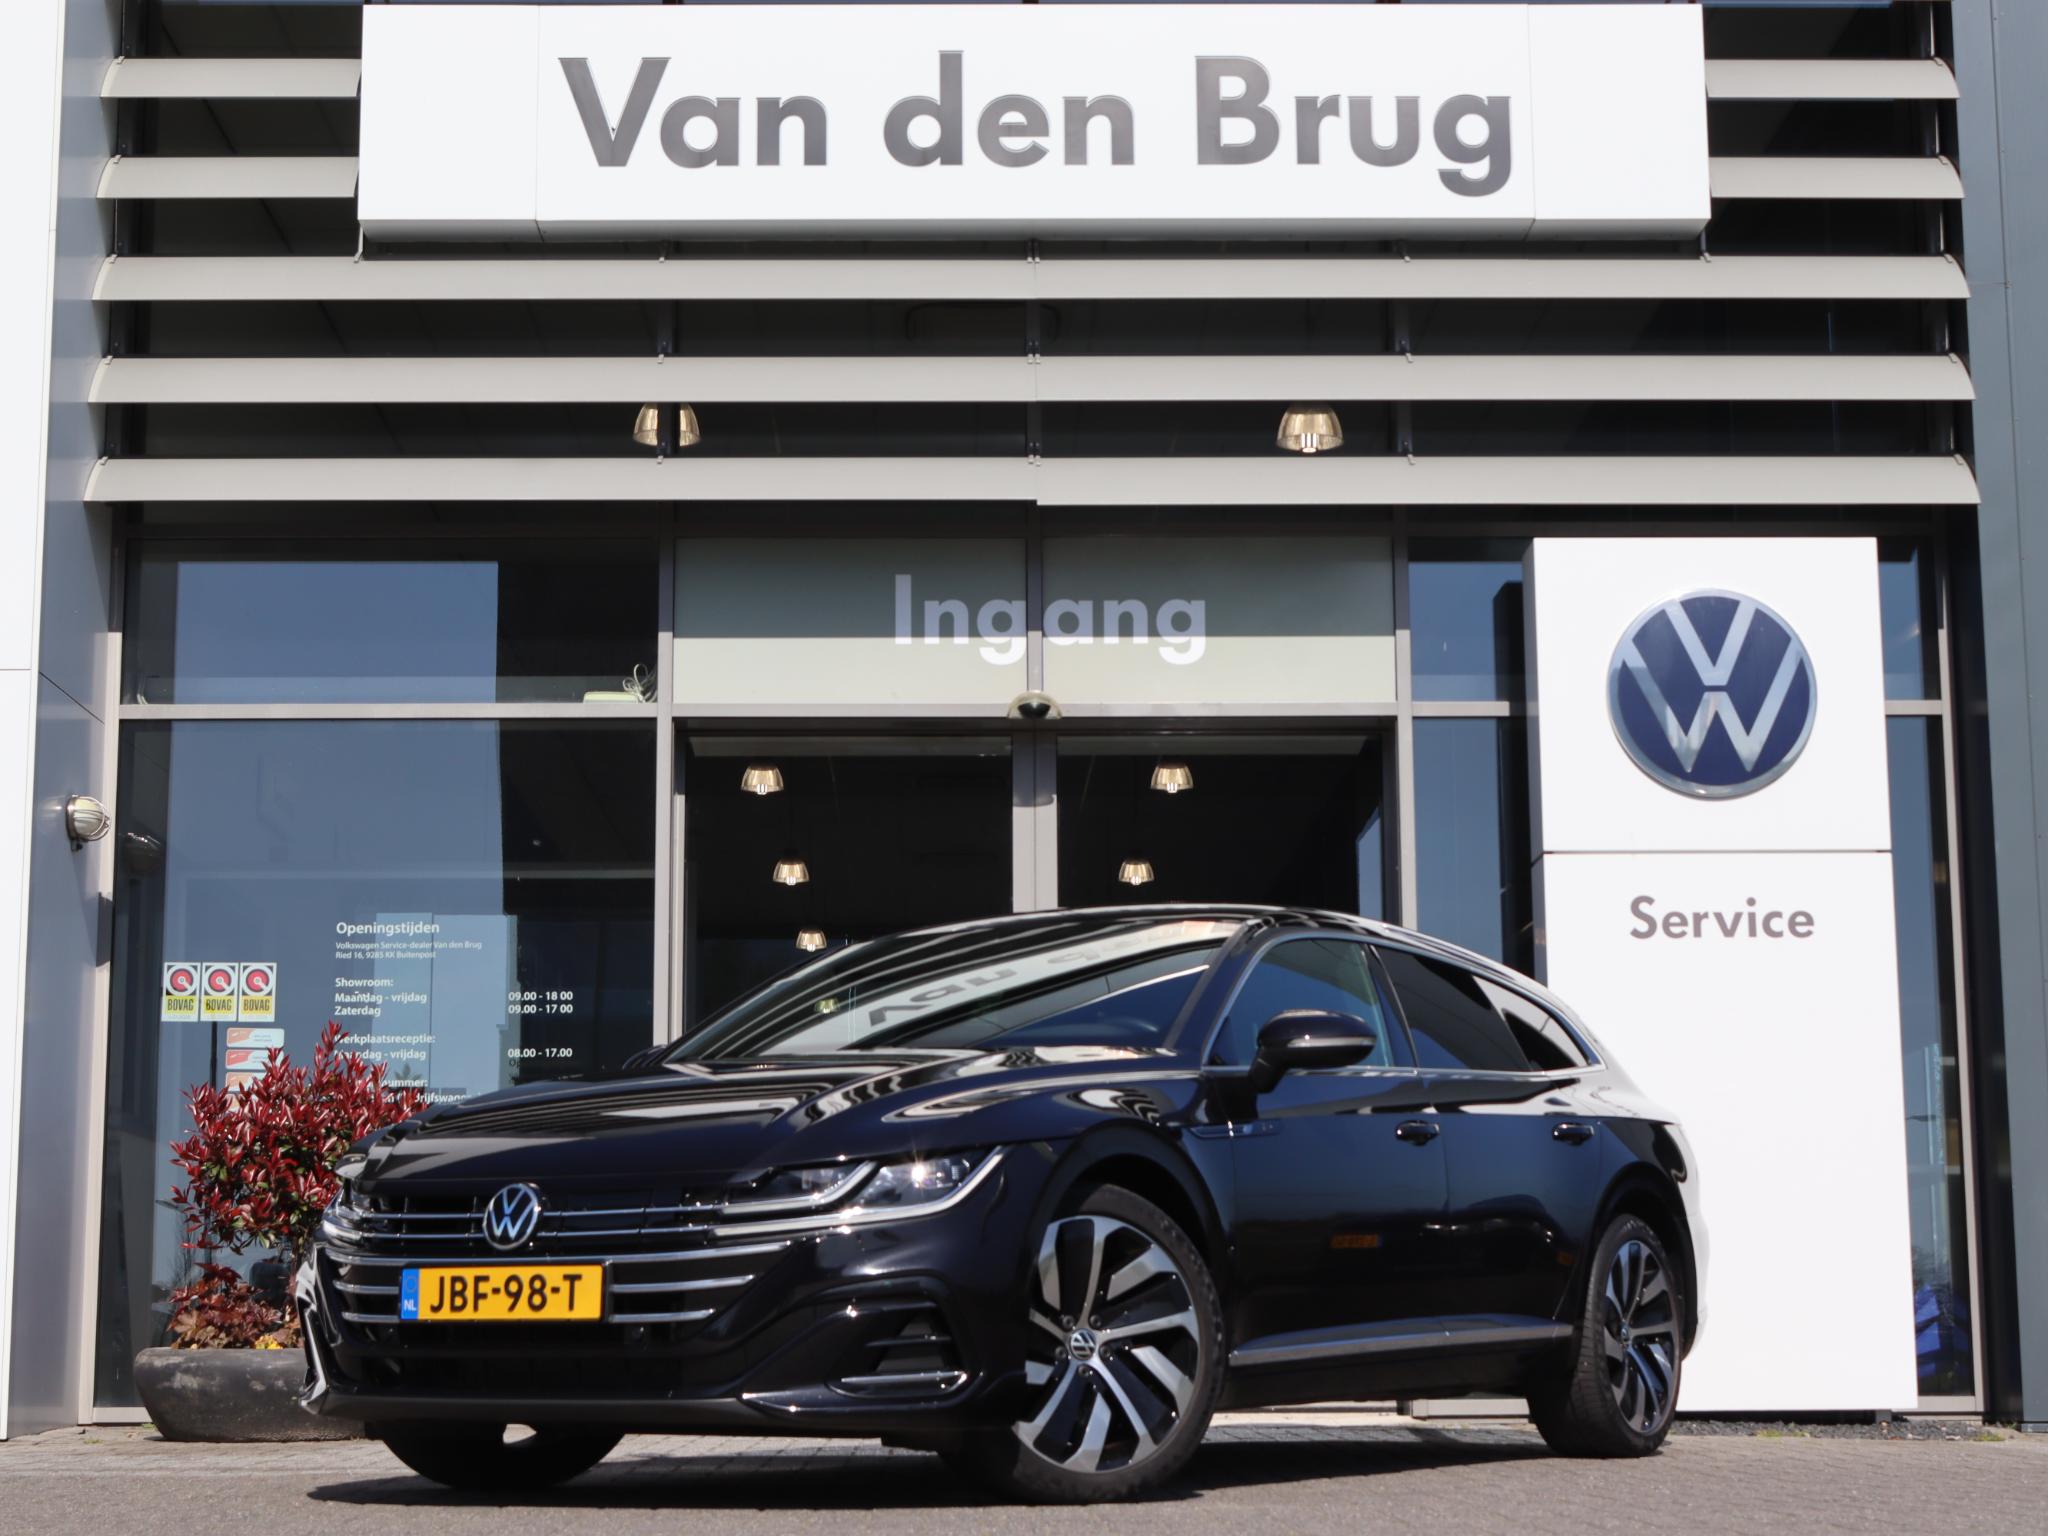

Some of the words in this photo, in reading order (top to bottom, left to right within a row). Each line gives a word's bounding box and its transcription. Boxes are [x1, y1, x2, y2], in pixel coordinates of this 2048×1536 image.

[558, 56, 828, 169] Van
[883, 50, 1136, 168] den
[1194, 54, 1513, 198] Brug
[894, 573, 1207, 666] Ingang
[1612, 592, 1812, 787] VW
[1629, 894, 1815, 940] Service
[335, 921, 440, 937] Openingstijden
[335, 941, 380, 950] Volkswagen
[380, 941, 432, 949] Service-dealer
[335, 951, 352, 960] Ried
[335, 977, 394, 988] Showroom:
[167, 998, 194, 1012] BOVAG
[205, 998, 232, 1012] BOVAG
[243, 998, 270, 1012] BOVAG
[334, 992, 383, 1005] Maandag
[391, 992, 428, 1004] vrijdag
[508, 991, 537, 1001] 09.00
[334, 1005, 382, 1017] Zaterdag
[508, 1004, 537, 1014] 09.00
[390, 1049, 427, 1061] vrijdag
[507, 1048, 536, 1058] 08.00
[545, 1048, 573, 1058] 17.00
[429, 1273, 583, 1313] JBF-98-T
[403, 1299, 416, 1311] NL
